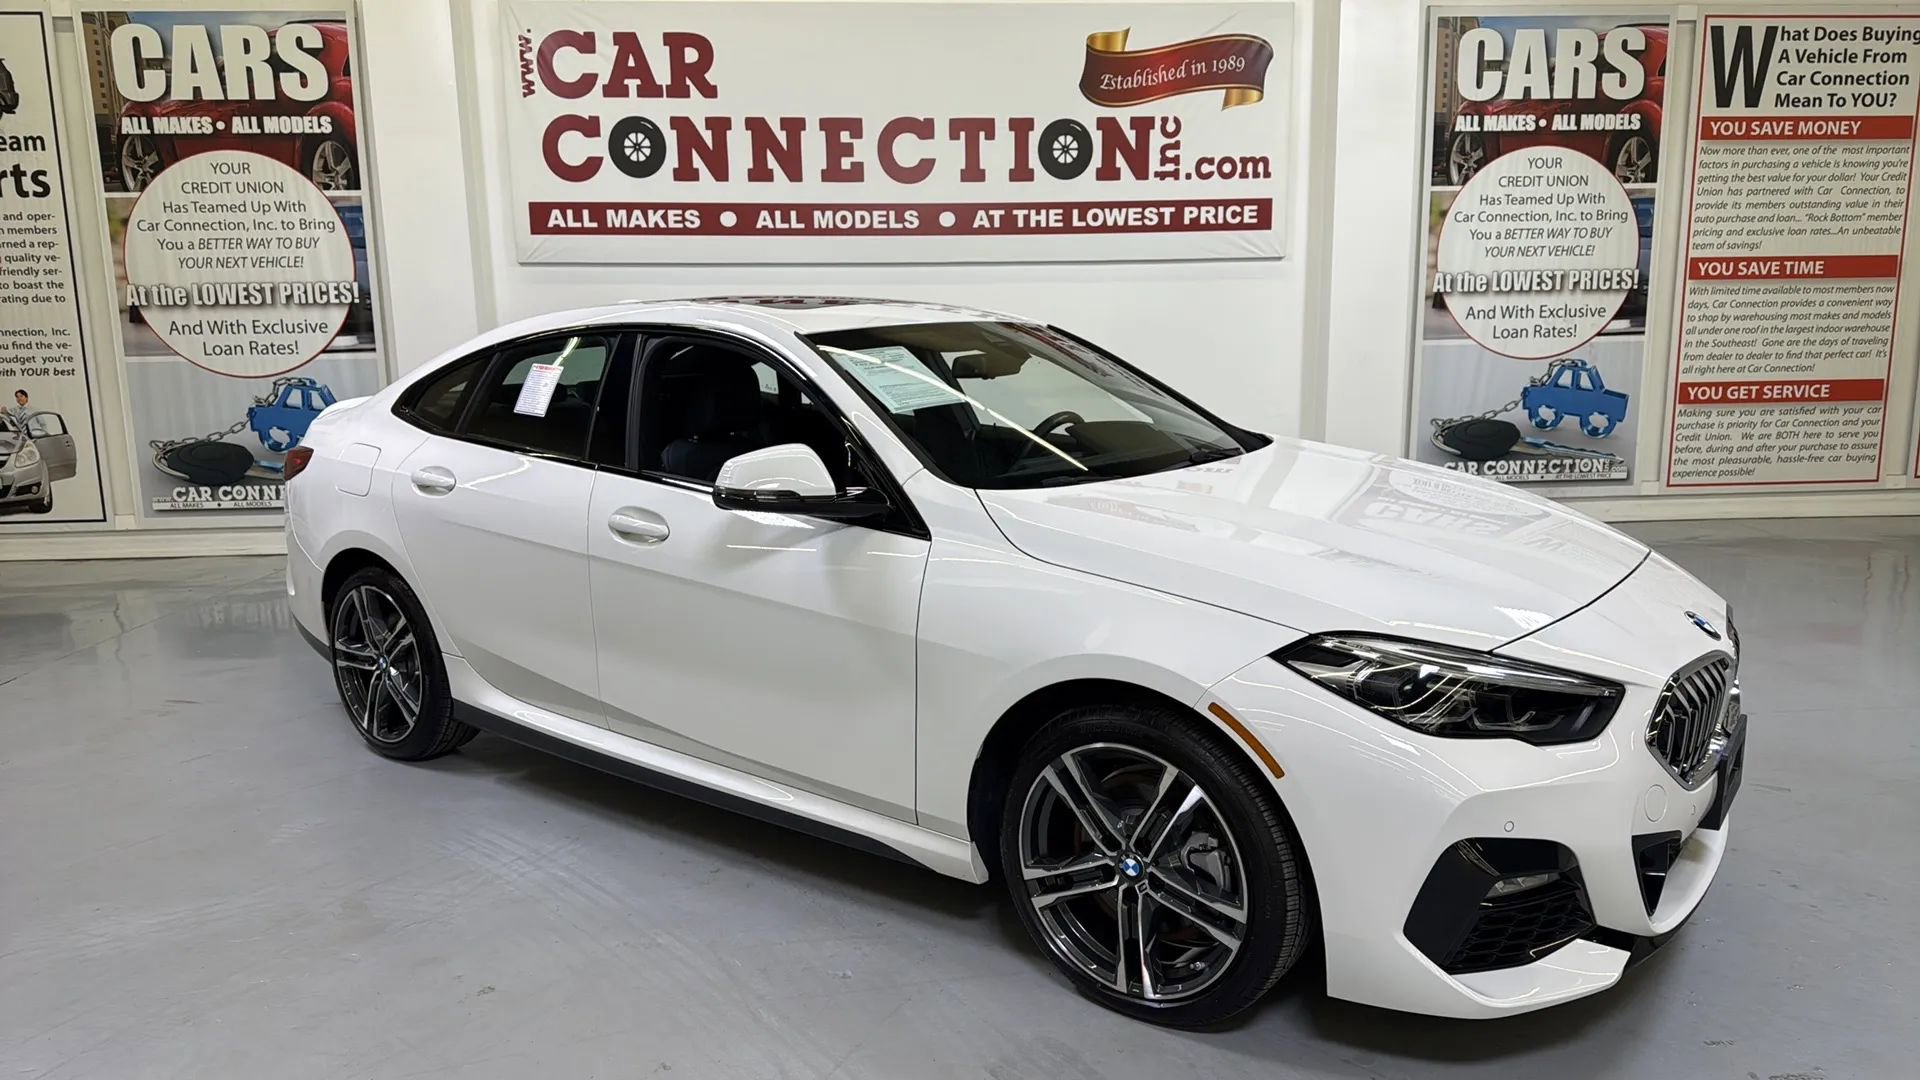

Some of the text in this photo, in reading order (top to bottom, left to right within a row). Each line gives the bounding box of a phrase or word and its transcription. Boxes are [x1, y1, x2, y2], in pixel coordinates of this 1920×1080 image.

[1814, 26, 1858, 42] Does
[1862, 26, 1920, 45] Buying
[110, 23, 329, 102] CARS
[1457, 26, 1646, 102] CARS
[1778, 48, 1908, 64] A Vehicle From
[537, 29, 718, 100] CAR
[1100, 55, 1246, 90] Established in 1989
[1776, 70, 1910, 86] Car Connection
[1775, 92, 1898, 108] Mean To YOU?
[121, 116, 333, 135] ALL MAKES ALL MODELS
[1455, 113, 1641, 132] ALL MAKES ALL MODELS
[1710, 120, 1862, 136] YOU SAVE MONEY
[542, 114, 1156, 183] CONNECTION
[1700, 146, 1720, 156] Now
[1722, 147, 1745, 155] more
[1748, 146, 1768, 155] than
[1792, 147, 1810, 155] one
[1811, 145, 1822, 155] of
[1823, 145, 1838, 155] the
[1842, 146, 1864, 155] most
[210, 162, 251, 175] YOUR
[1185, 155, 1272, 181] .com
[1528, 157, 1563, 169] YOUR
[181, 181, 284, 195] CREDIT UNION
[1498, 175, 1589, 188] CREDIT UNION
[1479, 192, 1606, 207] Has Teamed Up With
[163, 200, 306, 216] Has Teamed Up With
[3, 212, 55, 223] and oper-
[547, 204, 1258, 229] ALL MAKES ALL MODELS AT THE LOWEST PRICE
[1454, 209, 1629, 224] Car Connection, Inc. to Bring
[7, 225, 58, 235] members
[137, 218, 336, 234] Car Connection, Inc. to Bring
[1469, 226, 1613, 241] You a BETTER WAY TO BUY
[38, 241, 59, 250] rep-
[157, 236, 321, 251] You a BETTER WAY TO BUY
[1485, 244, 1596, 258] YOUR NEXT VEHICLE!
[5, 253, 41, 264] quality
[179, 255, 305, 270] YOUR NEXT VEHICLE!
[43, 268, 62, 276] ser-
[1698, 260, 1825, 276] YOU SAVE TIME
[13, 280, 64, 290] boast the
[1432, 269, 1640, 293] At the LOWEST PRICES!
[32, 294, 66, 303] due to
[126, 281, 360, 307] At the LOWEST PRICES!
[1465, 303, 1607, 321] And With Exclusive
[51, 327, 71, 336] Inc.
[169, 318, 329, 336] And With Exclusive
[1492, 323, 1577, 340] Loan Rates!
[12, 340, 33, 351] find
[35, 341, 53, 350] the
[203, 340, 300, 356] Loan Rates!
[41, 354, 74, 365] you're
[20, 366, 76, 377] YOUR best
[1688, 384, 1831, 401] YOU GET SERVICE
[1677, 408, 1713, 419] Making
[1716, 409, 1736, 417] sure
[1738, 409, 1756, 418] you
[1778, 406, 1816, 416] satisfied
[1819, 406, 1840, 415] with
[1842, 407, 1863, 416] your
[1866, 406, 1882, 414] car
[1483, 458, 1605, 475] CONNECTION
[172, 486, 213, 502] CAR
